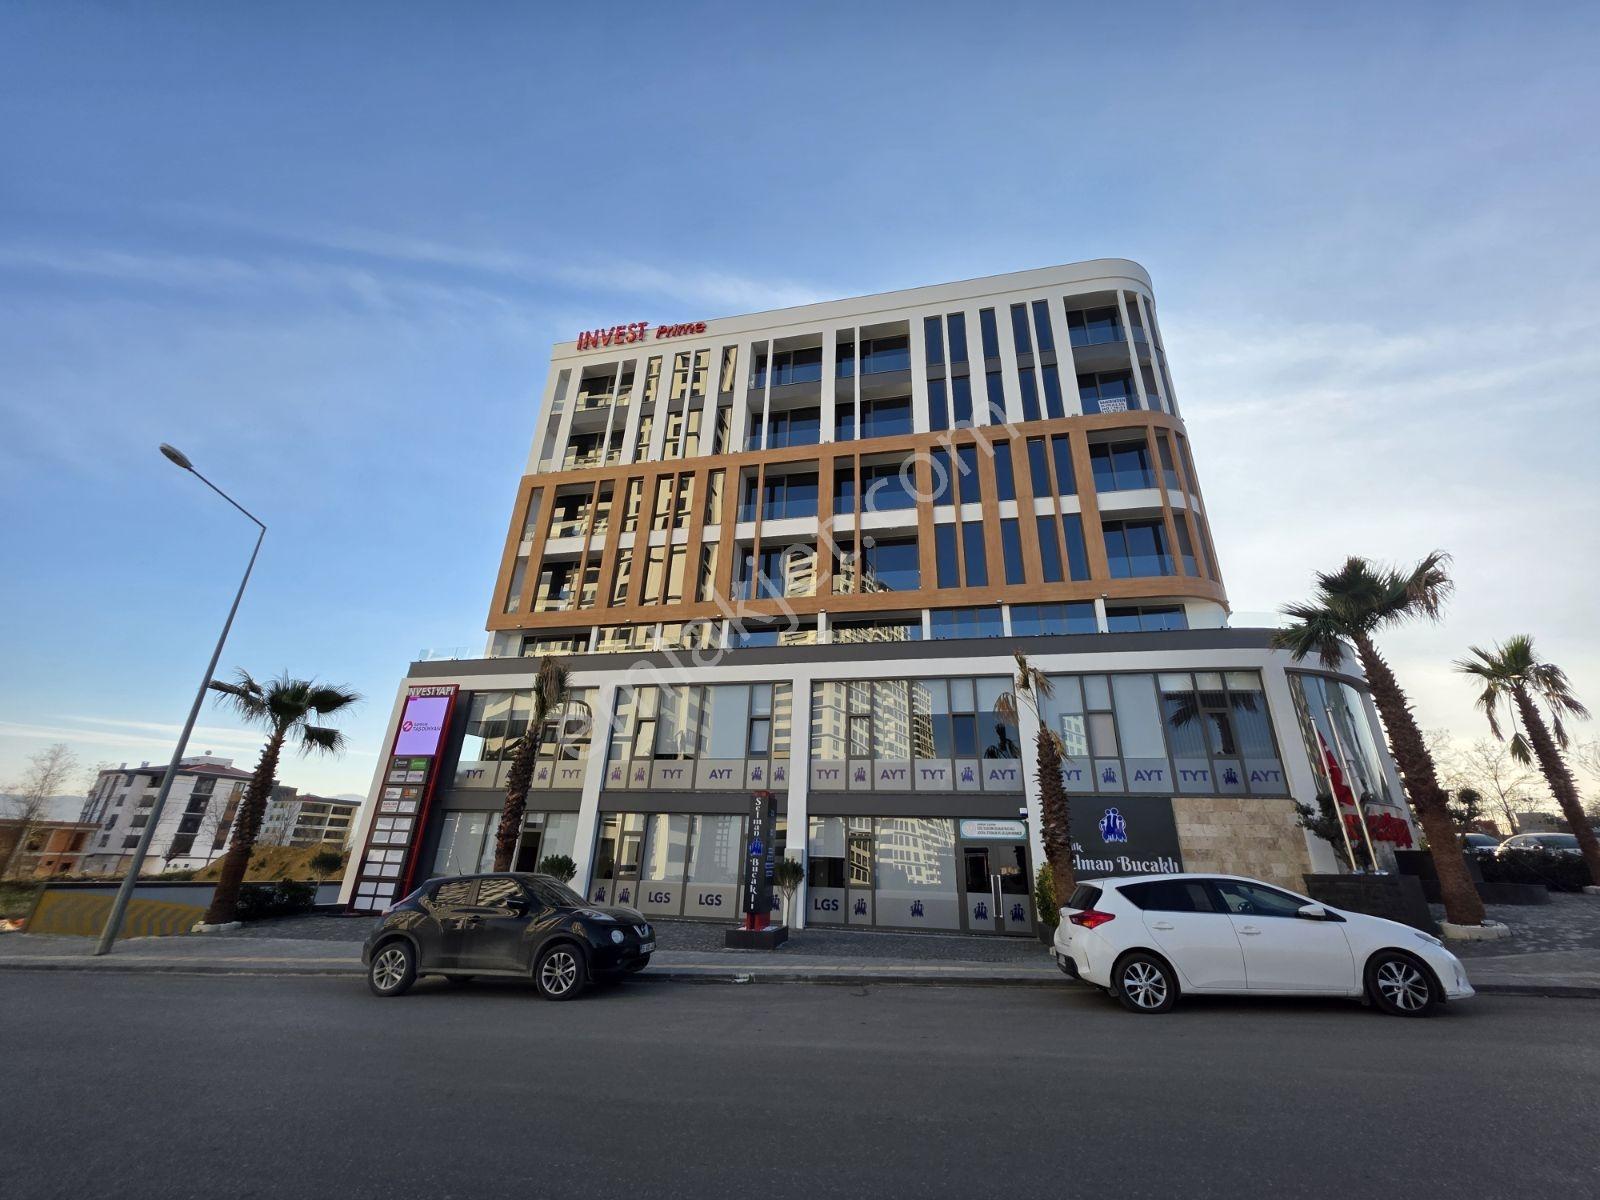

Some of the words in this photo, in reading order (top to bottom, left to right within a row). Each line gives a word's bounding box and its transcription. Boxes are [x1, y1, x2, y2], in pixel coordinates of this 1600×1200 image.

[577, 322, 650, 351] INVEST
[656, 321, 707, 339] Prime
[465, 769, 485, 779] TYT
[561, 769, 581, 779] TYT
[662, 769, 683, 780] TYT
[709, 769, 733, 780] AYT
[816, 769, 839, 780] TYT
[880, 769, 906, 780] AYT
[920, 769, 945, 780] TYT
[989, 769, 1016, 781] AYT
[1063, 769, 1082, 781] YT
[1134, 769, 1163, 782] AYT
[1179, 770, 1209, 782] TYT
[1250, 770, 1281, 783] AYT
[1072, 854, 1114, 872] lman
[1116, 856, 1179, 873] Bucaklı
[648, 892, 671, 904] LGS
[698, 894, 722, 906] LGS
[814, 899, 839, 911] LGS
